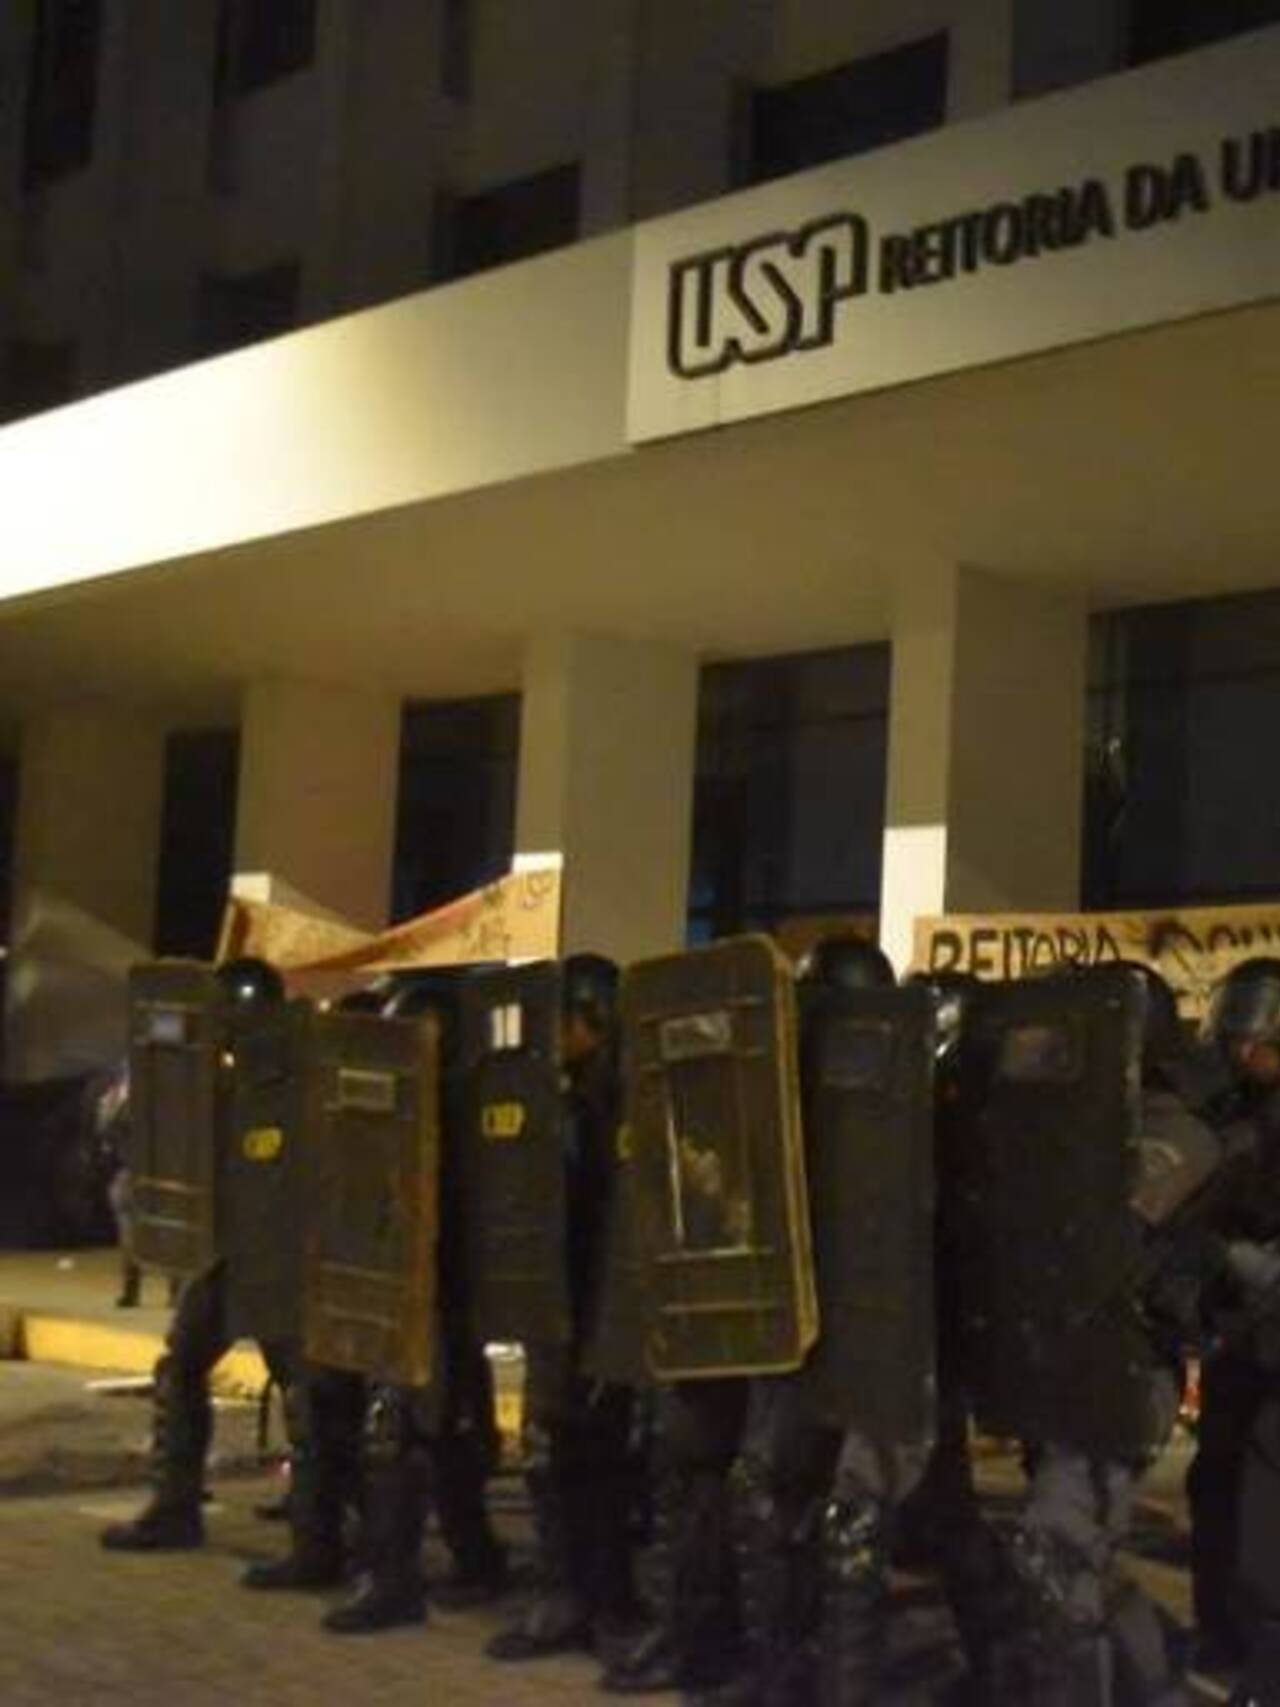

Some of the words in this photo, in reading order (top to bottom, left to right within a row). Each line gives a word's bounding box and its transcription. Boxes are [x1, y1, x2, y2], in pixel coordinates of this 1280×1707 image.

[667, 211, 869, 380] USP
[878, 178, 1114, 294] REITORIA
[1124, 153, 1210, 231] DA
